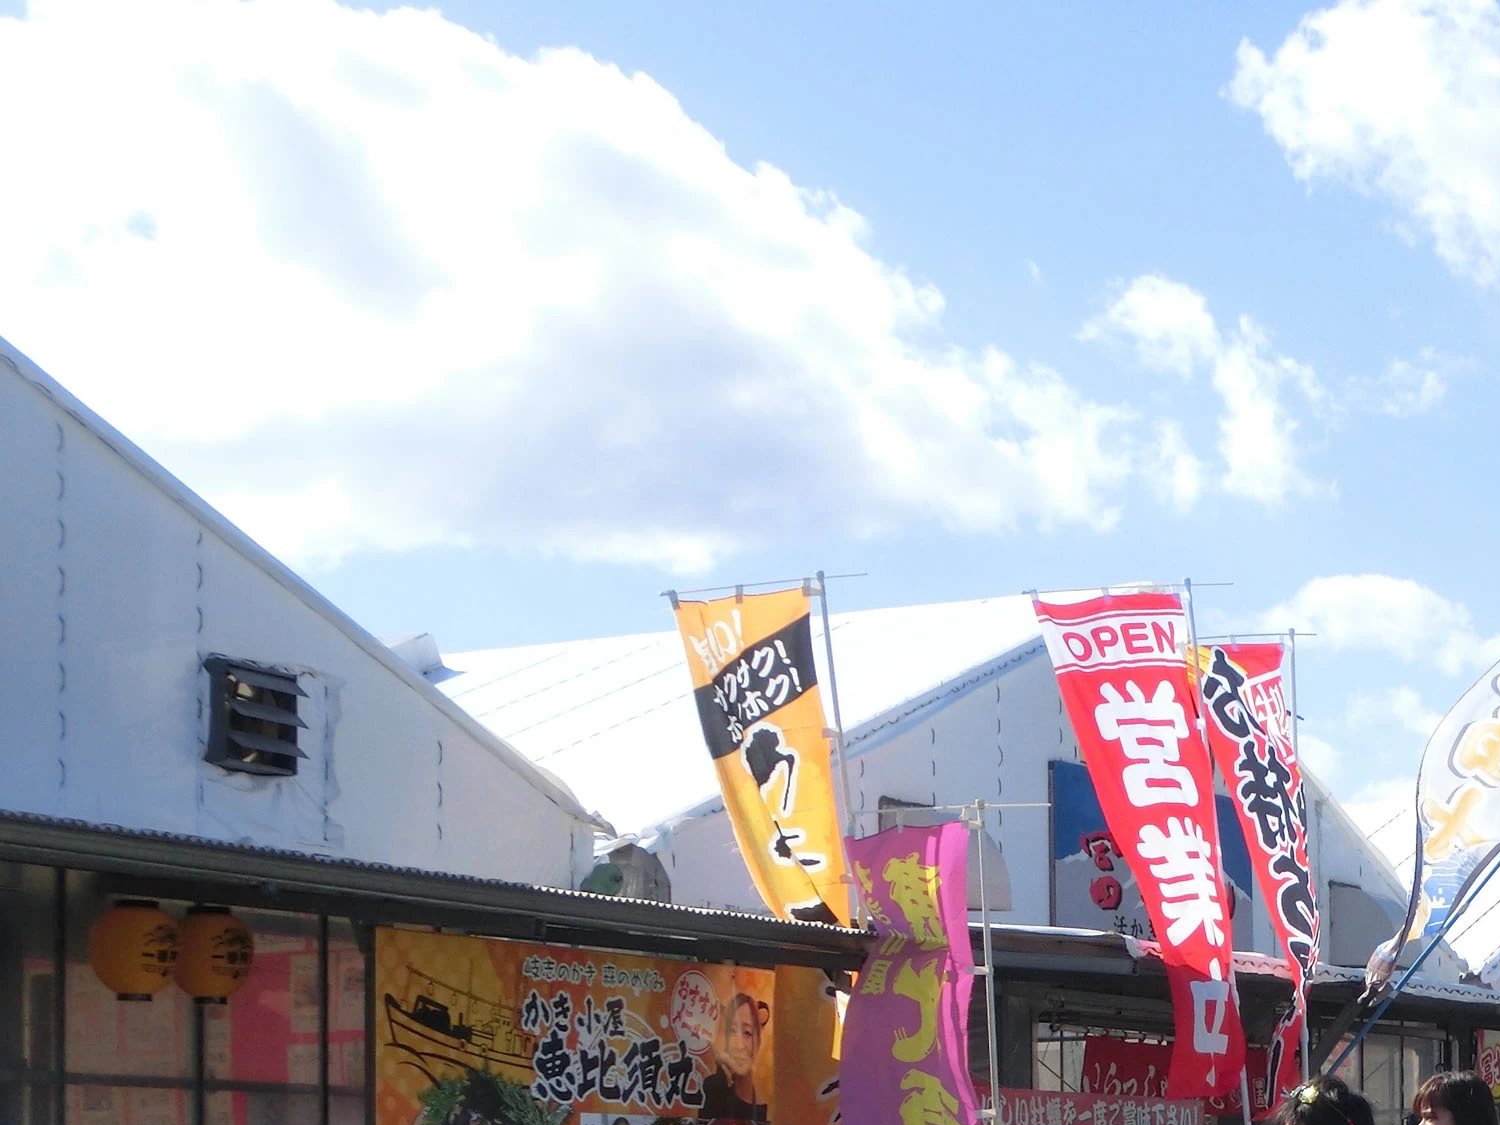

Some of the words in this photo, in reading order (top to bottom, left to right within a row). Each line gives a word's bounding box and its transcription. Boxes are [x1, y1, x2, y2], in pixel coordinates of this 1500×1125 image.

[1063, 620, 1175, 662] OPEN
[1095, 680, 1233, 1088] 営業中
[523, 955, 598, 985] 岐志のかき
[523, 990, 626, 1037] かき小屋
[533, 1030, 706, 1108] 恵比須丸
